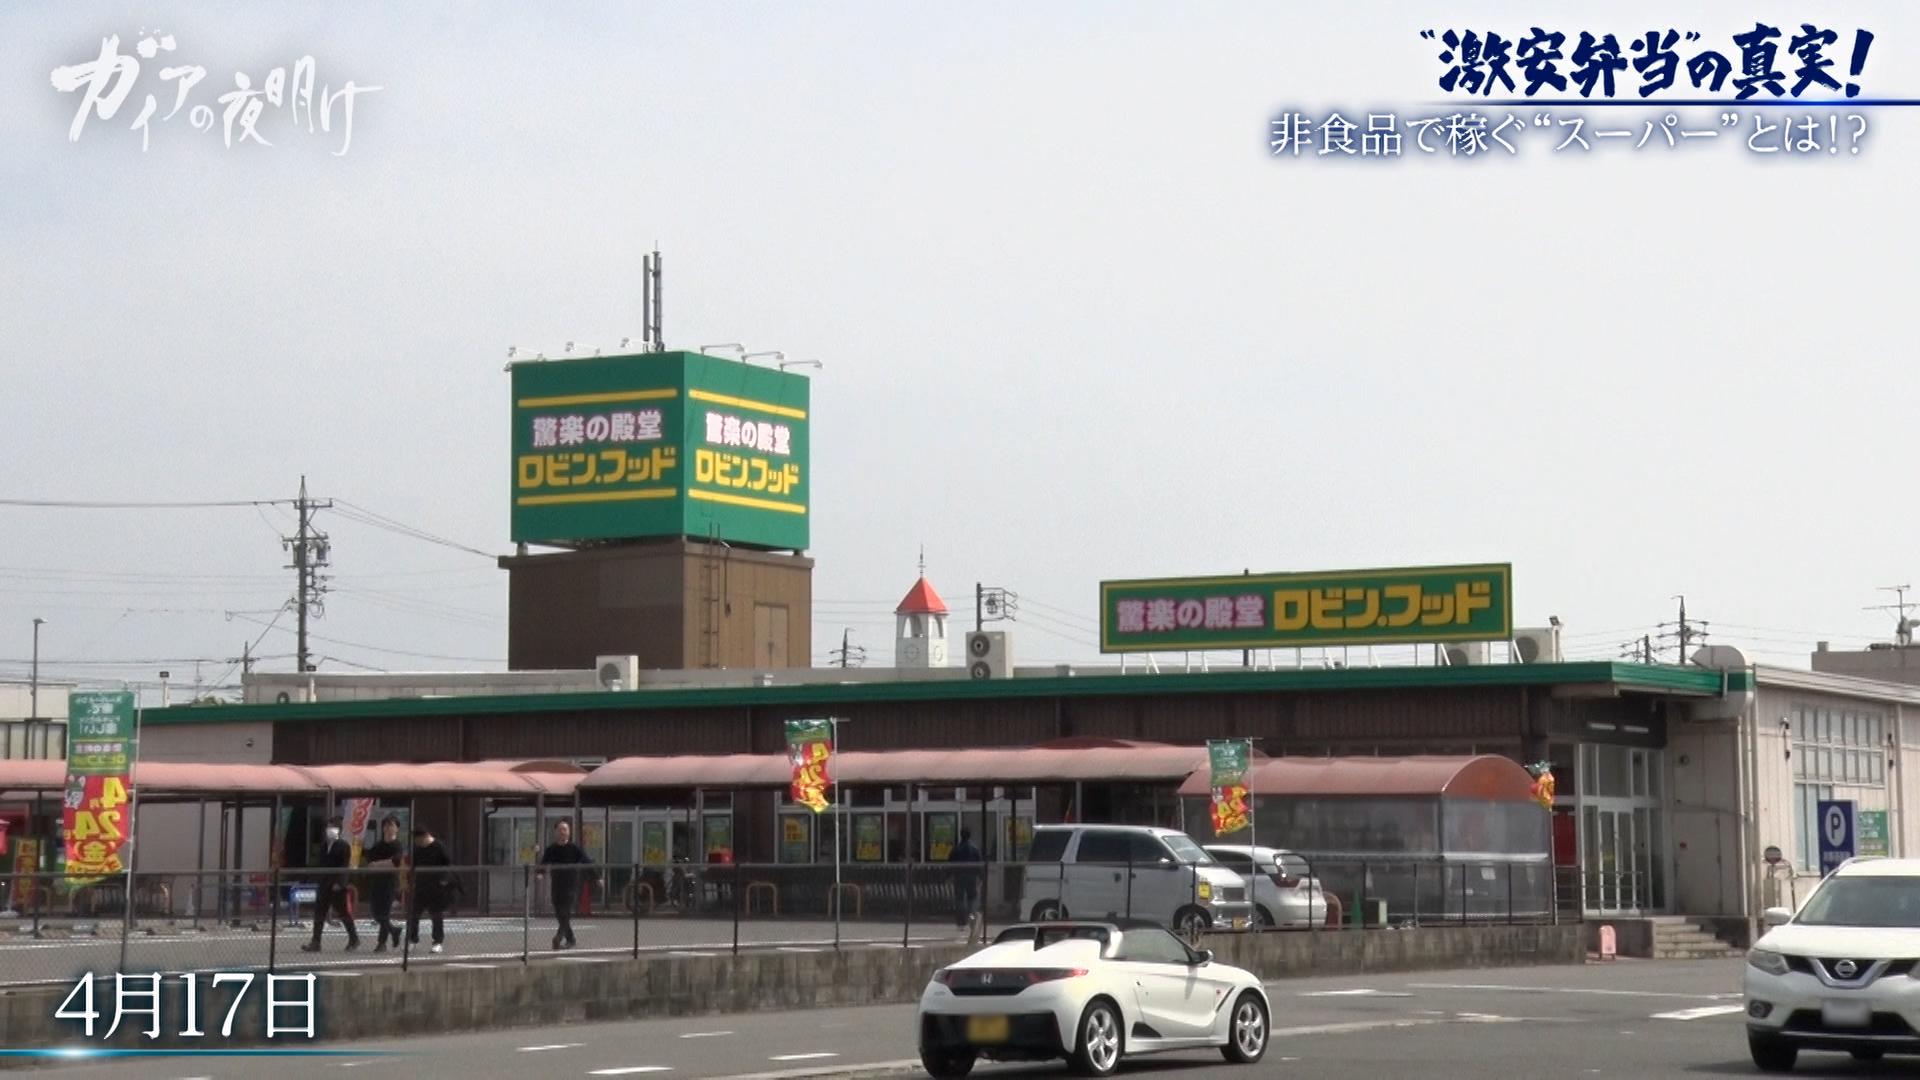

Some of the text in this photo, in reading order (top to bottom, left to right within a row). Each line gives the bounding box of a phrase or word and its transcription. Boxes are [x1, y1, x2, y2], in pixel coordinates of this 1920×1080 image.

[532, 409, 662, 447] 驚楽の殿堂
[1117, 595, 1266, 632] 驚楽の殿堂
[1830, 813, 1841, 840] P
